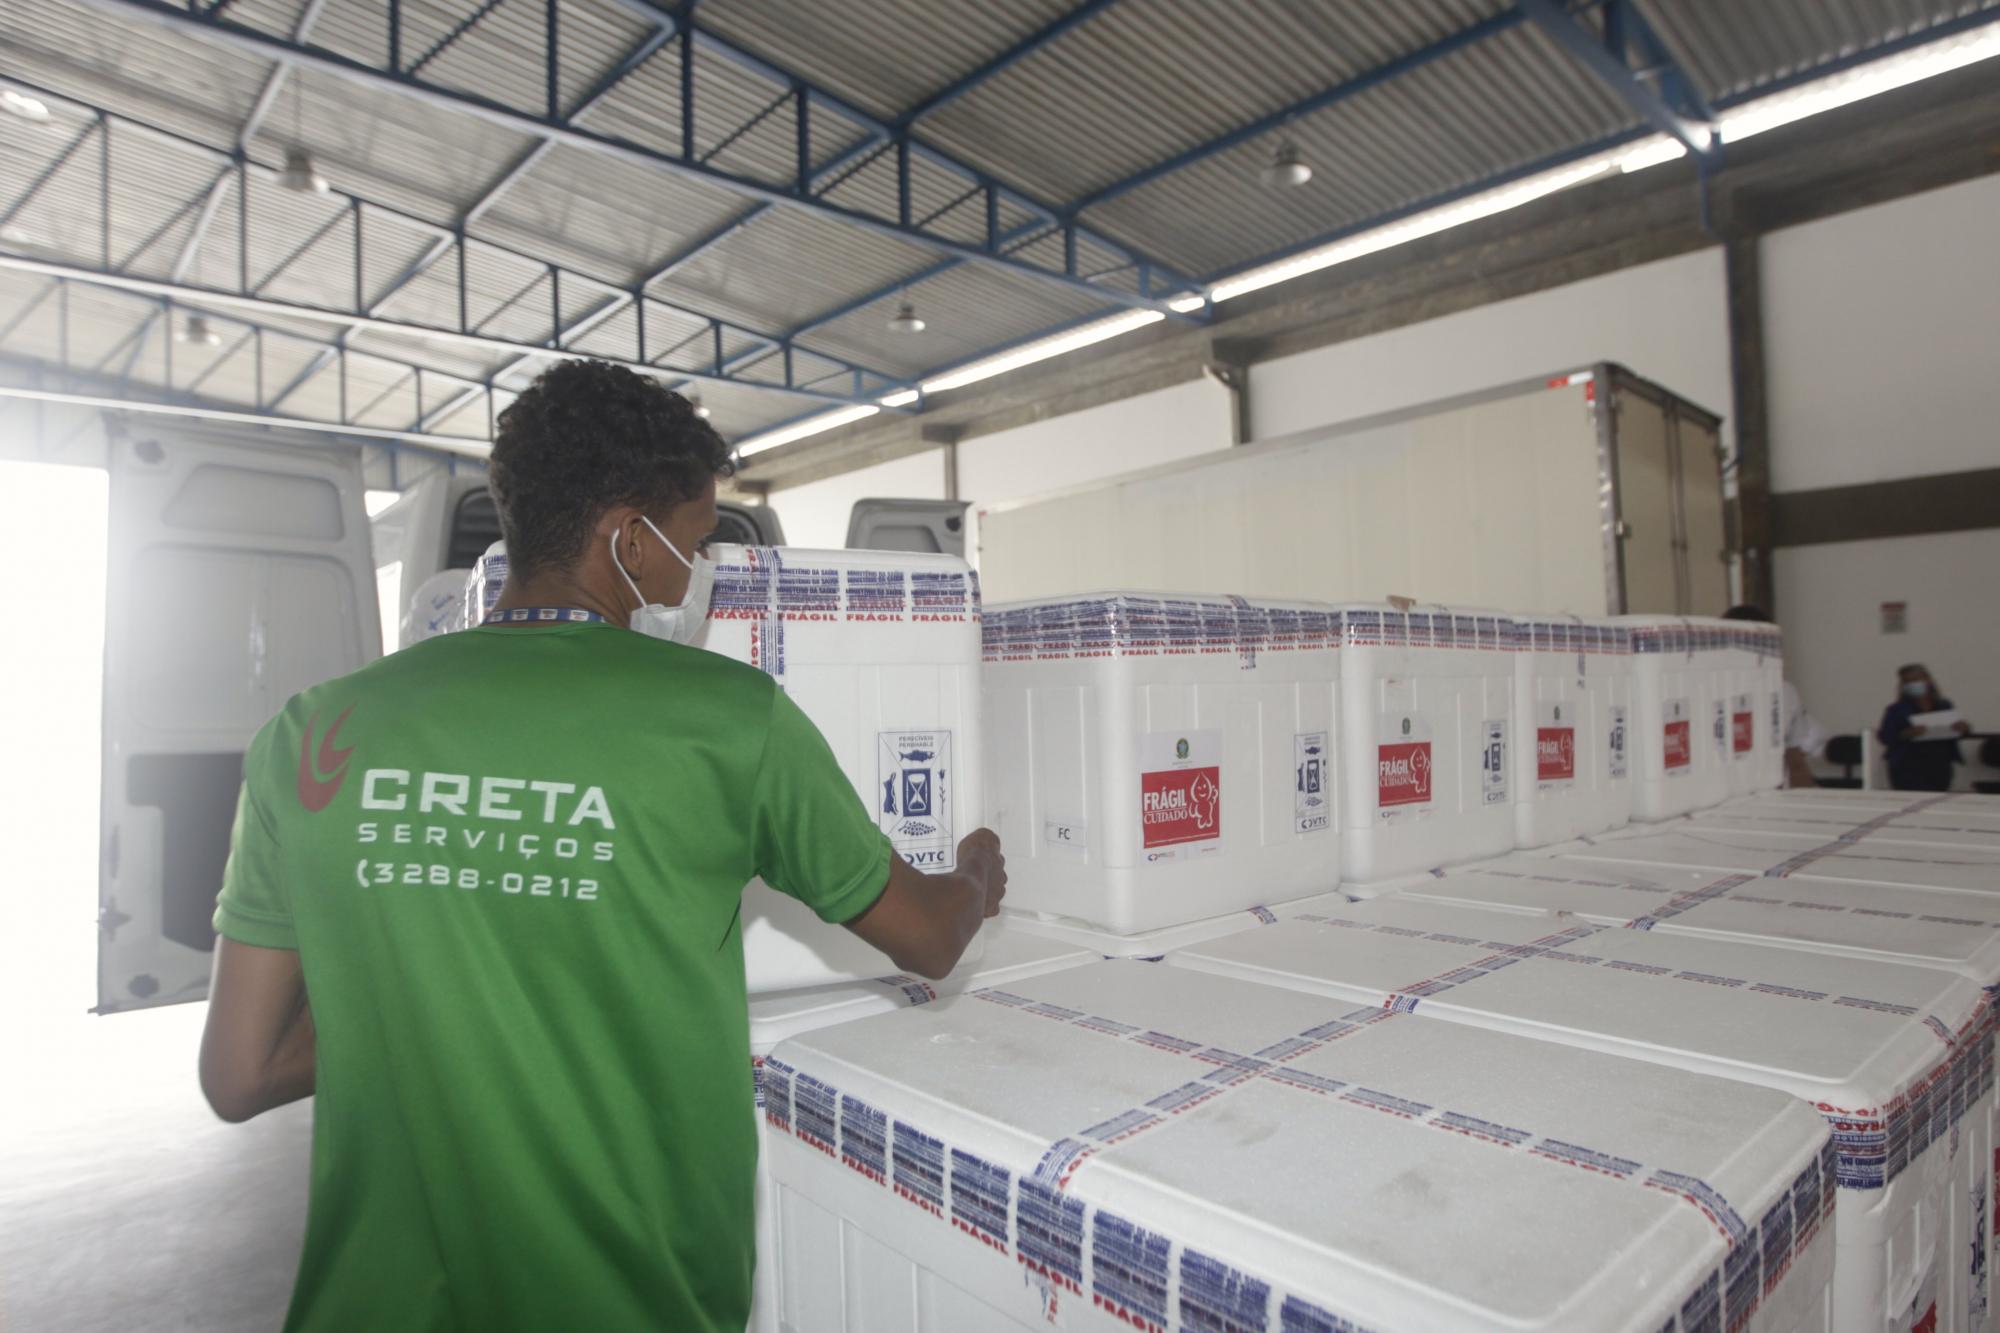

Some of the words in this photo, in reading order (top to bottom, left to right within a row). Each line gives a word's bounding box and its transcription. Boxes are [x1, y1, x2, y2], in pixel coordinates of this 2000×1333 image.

[1380, 756, 1409, 777] FRÁGIL
[1143, 785, 1187, 812] FRÁGIL
[1143, 807, 1189, 824] CUIDADO
[358, 822, 615, 861] SERVIÇOS
[1058, 827, 1071, 840] FC
